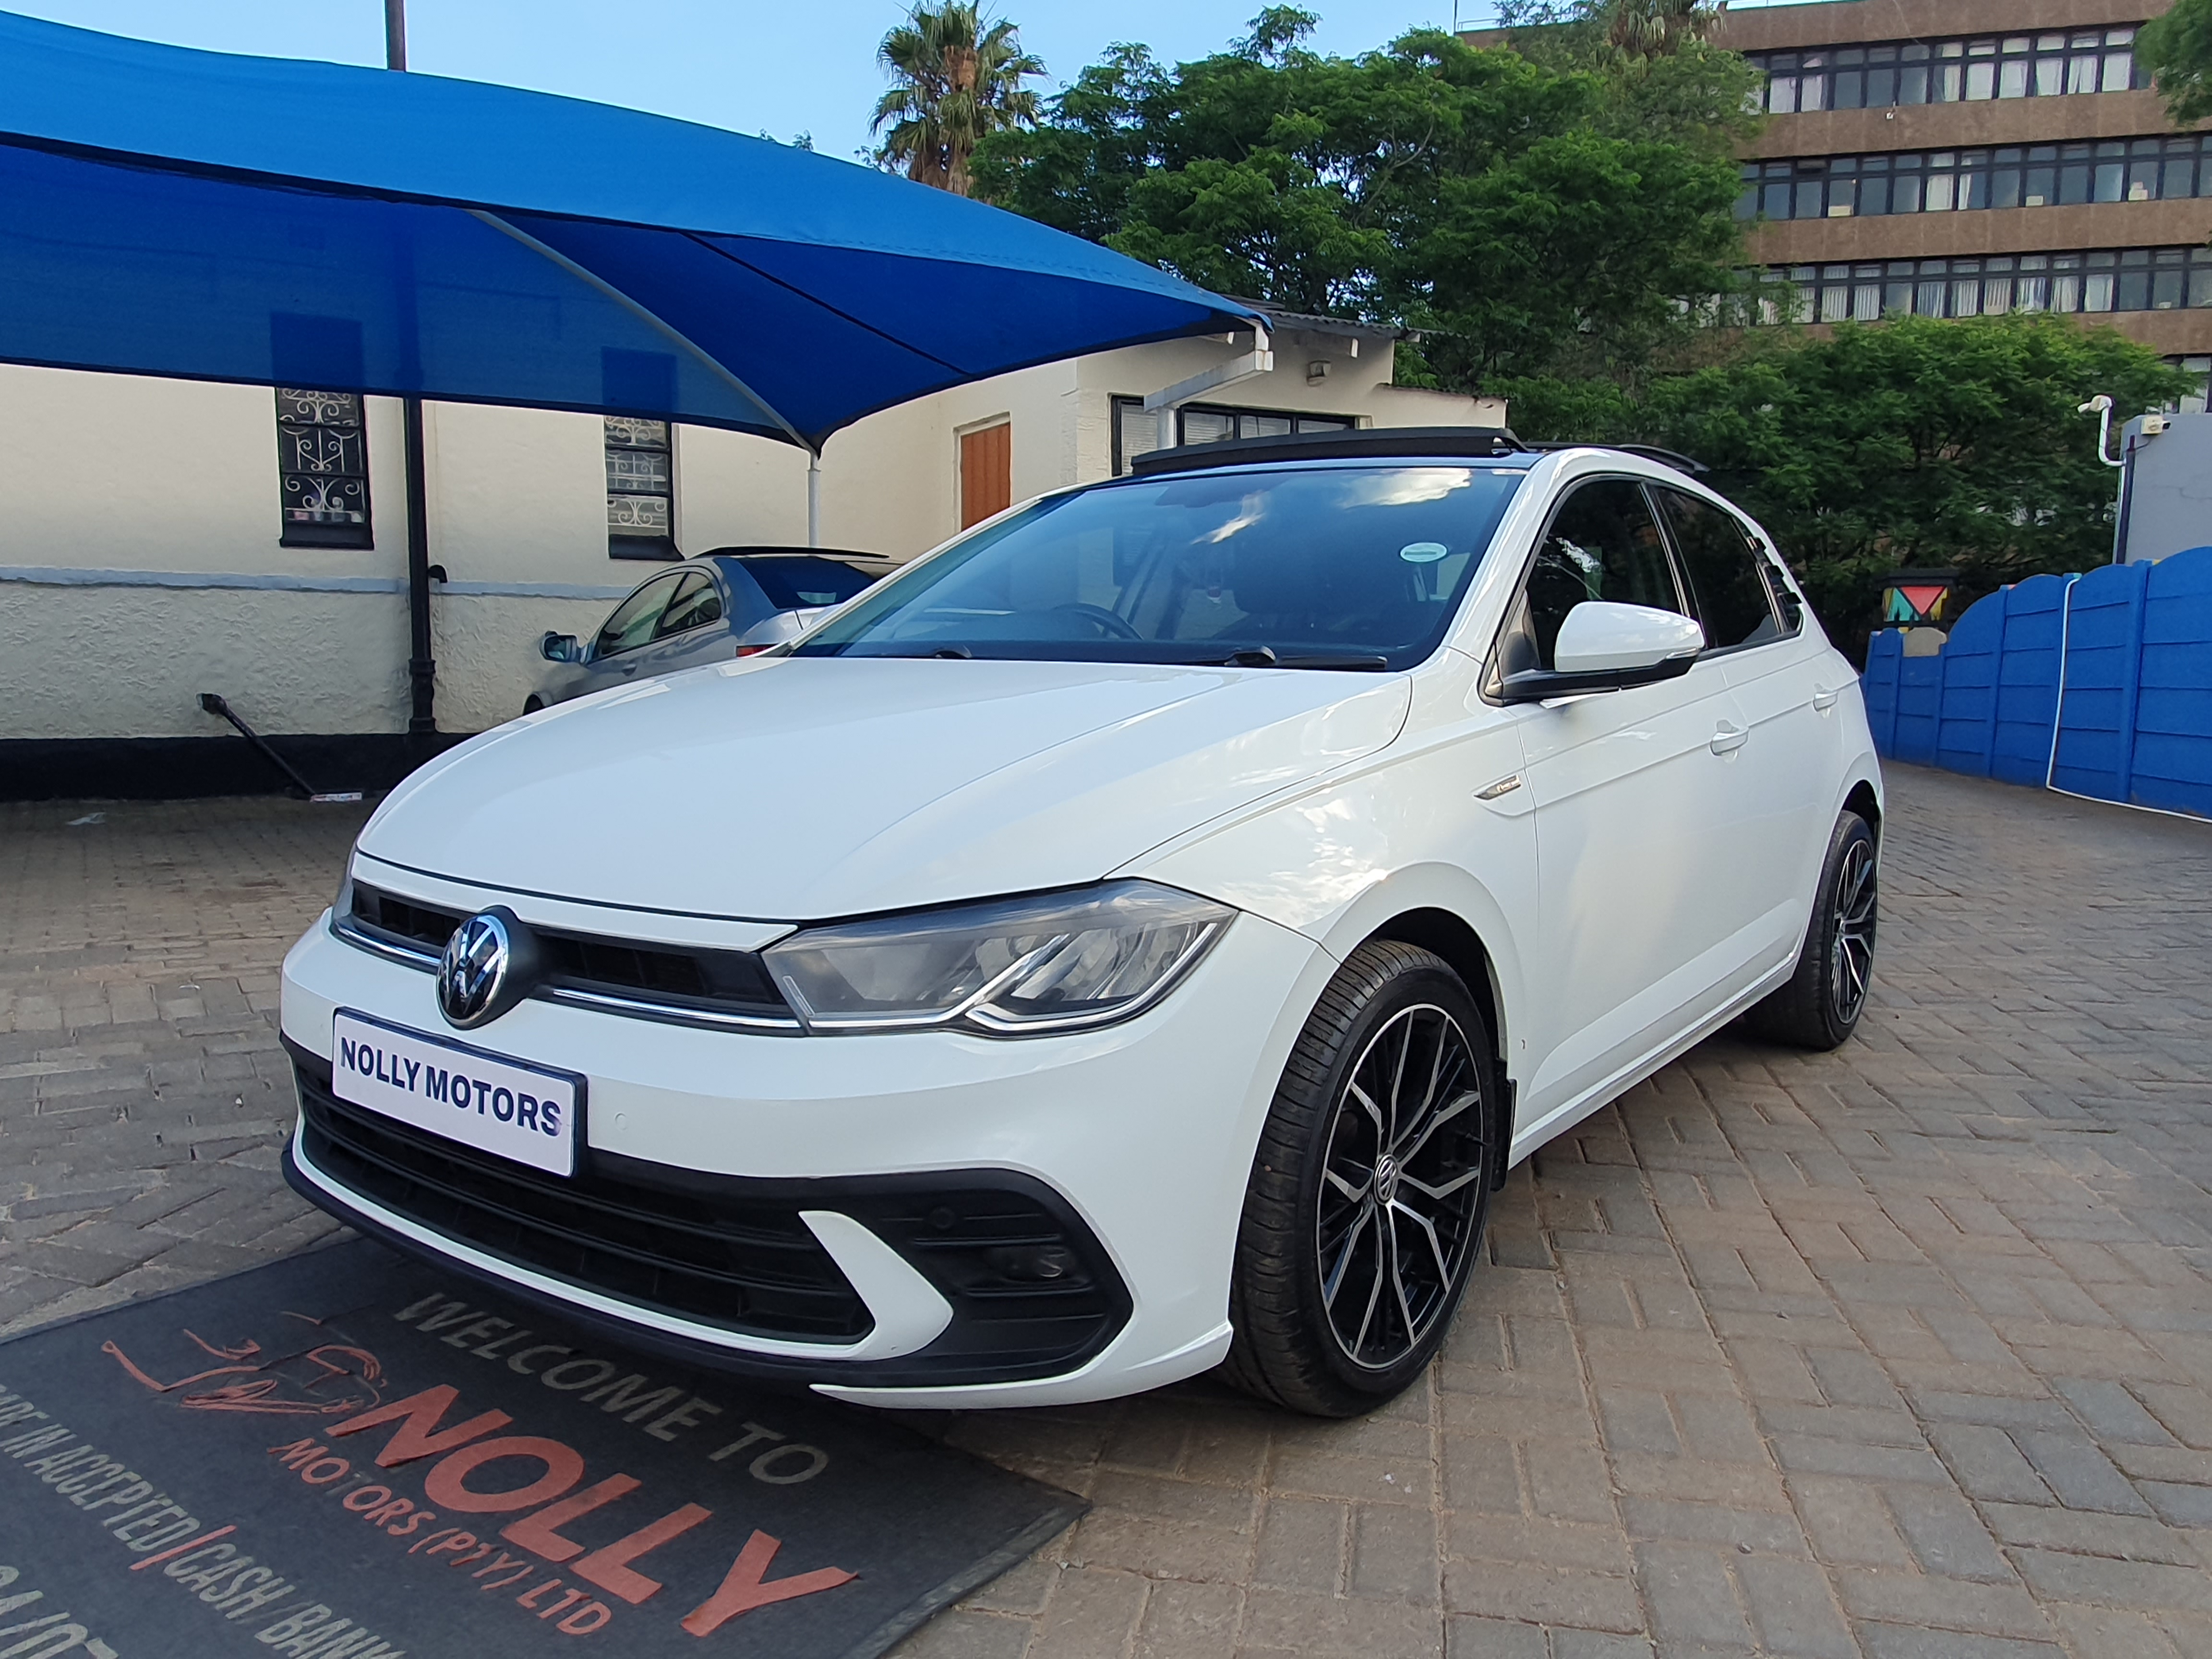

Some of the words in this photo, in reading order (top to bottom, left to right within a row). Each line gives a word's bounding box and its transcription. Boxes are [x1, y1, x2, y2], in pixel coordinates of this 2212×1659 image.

[340, 1036, 421, 1092] NOLLY
[425, 1065, 561, 1137] MOTORS
[393, 1292, 722, 1442] WELCOME
[708, 1421, 829, 1484] TO
[324, 1383, 858, 1637] NOLLY
[516, 1579, 612, 1635] LTD
